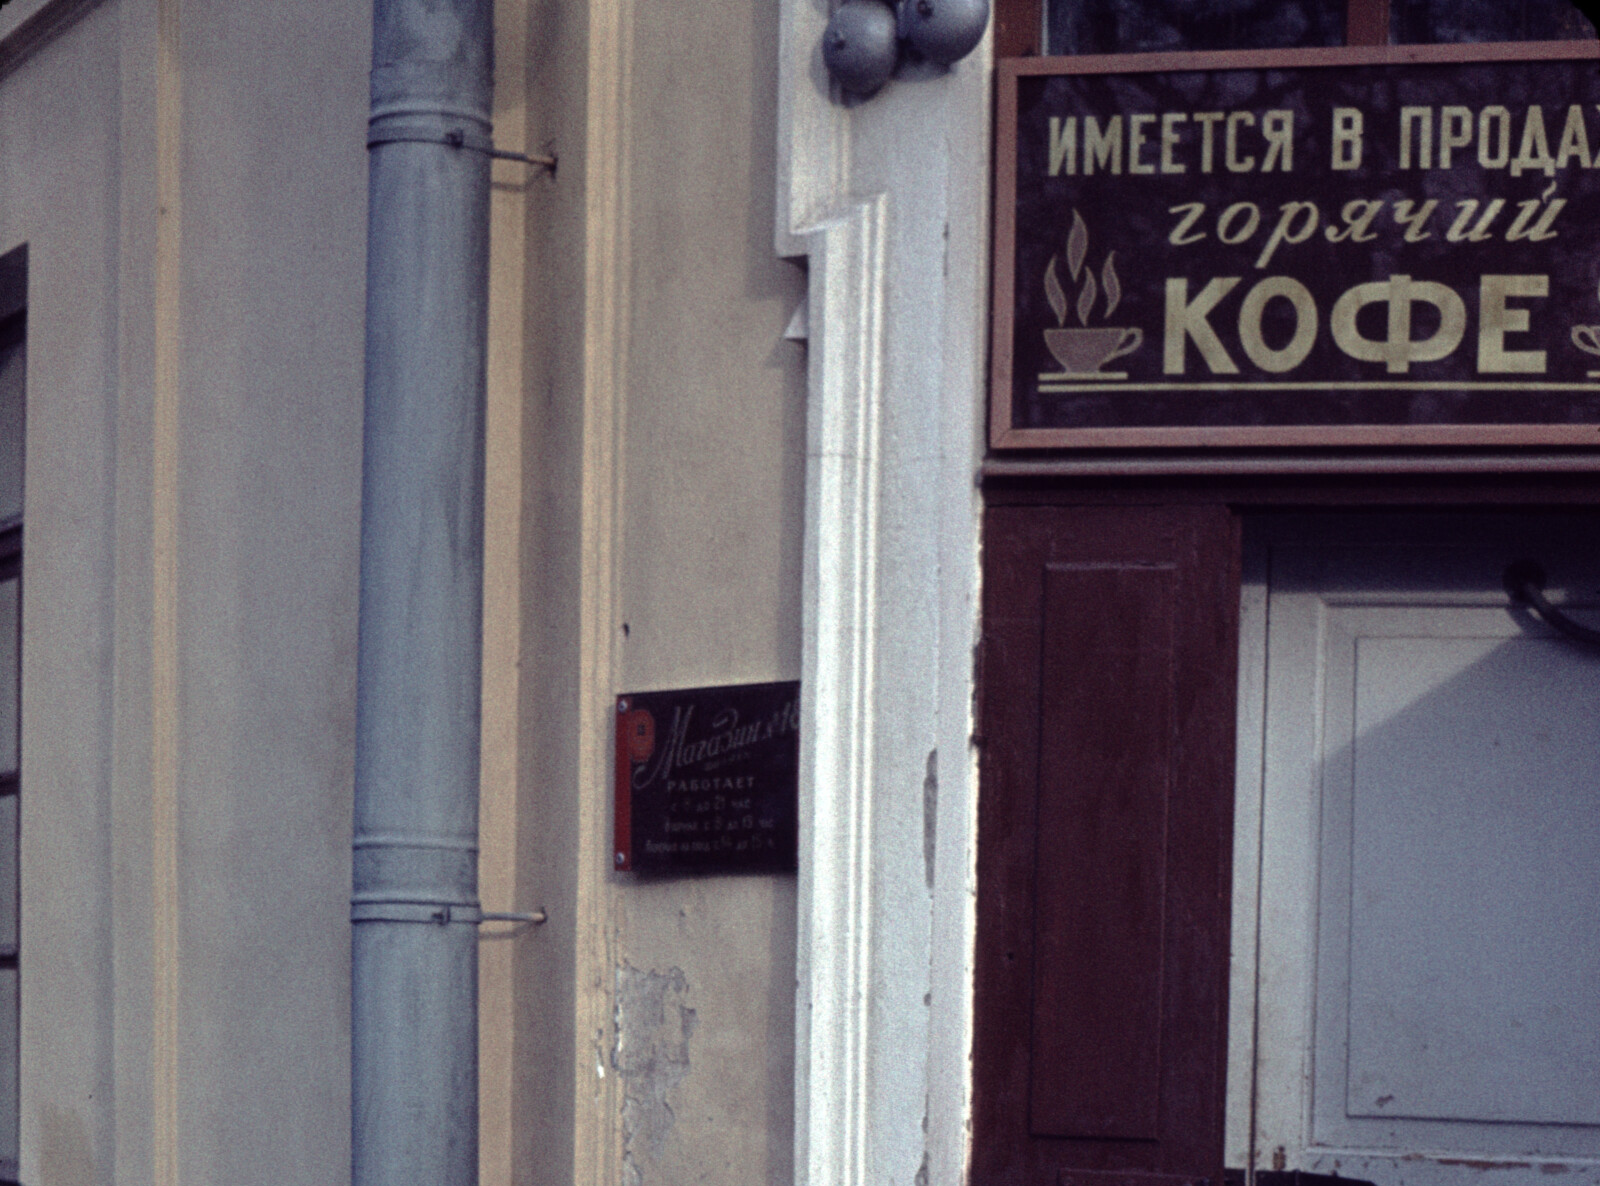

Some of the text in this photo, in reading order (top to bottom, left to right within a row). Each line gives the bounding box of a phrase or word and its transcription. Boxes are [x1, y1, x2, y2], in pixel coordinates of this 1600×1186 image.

[1049, 105, 1600, 176] ИМЕЕТСЯ В ПРОДА
[1169, 182, 1566, 268] горячий
[1164, 275, 1548, 374] КОФЕ
[633, 705, 761, 789] Магазин
[666, 776, 755, 792] РАБОТАЕТ
